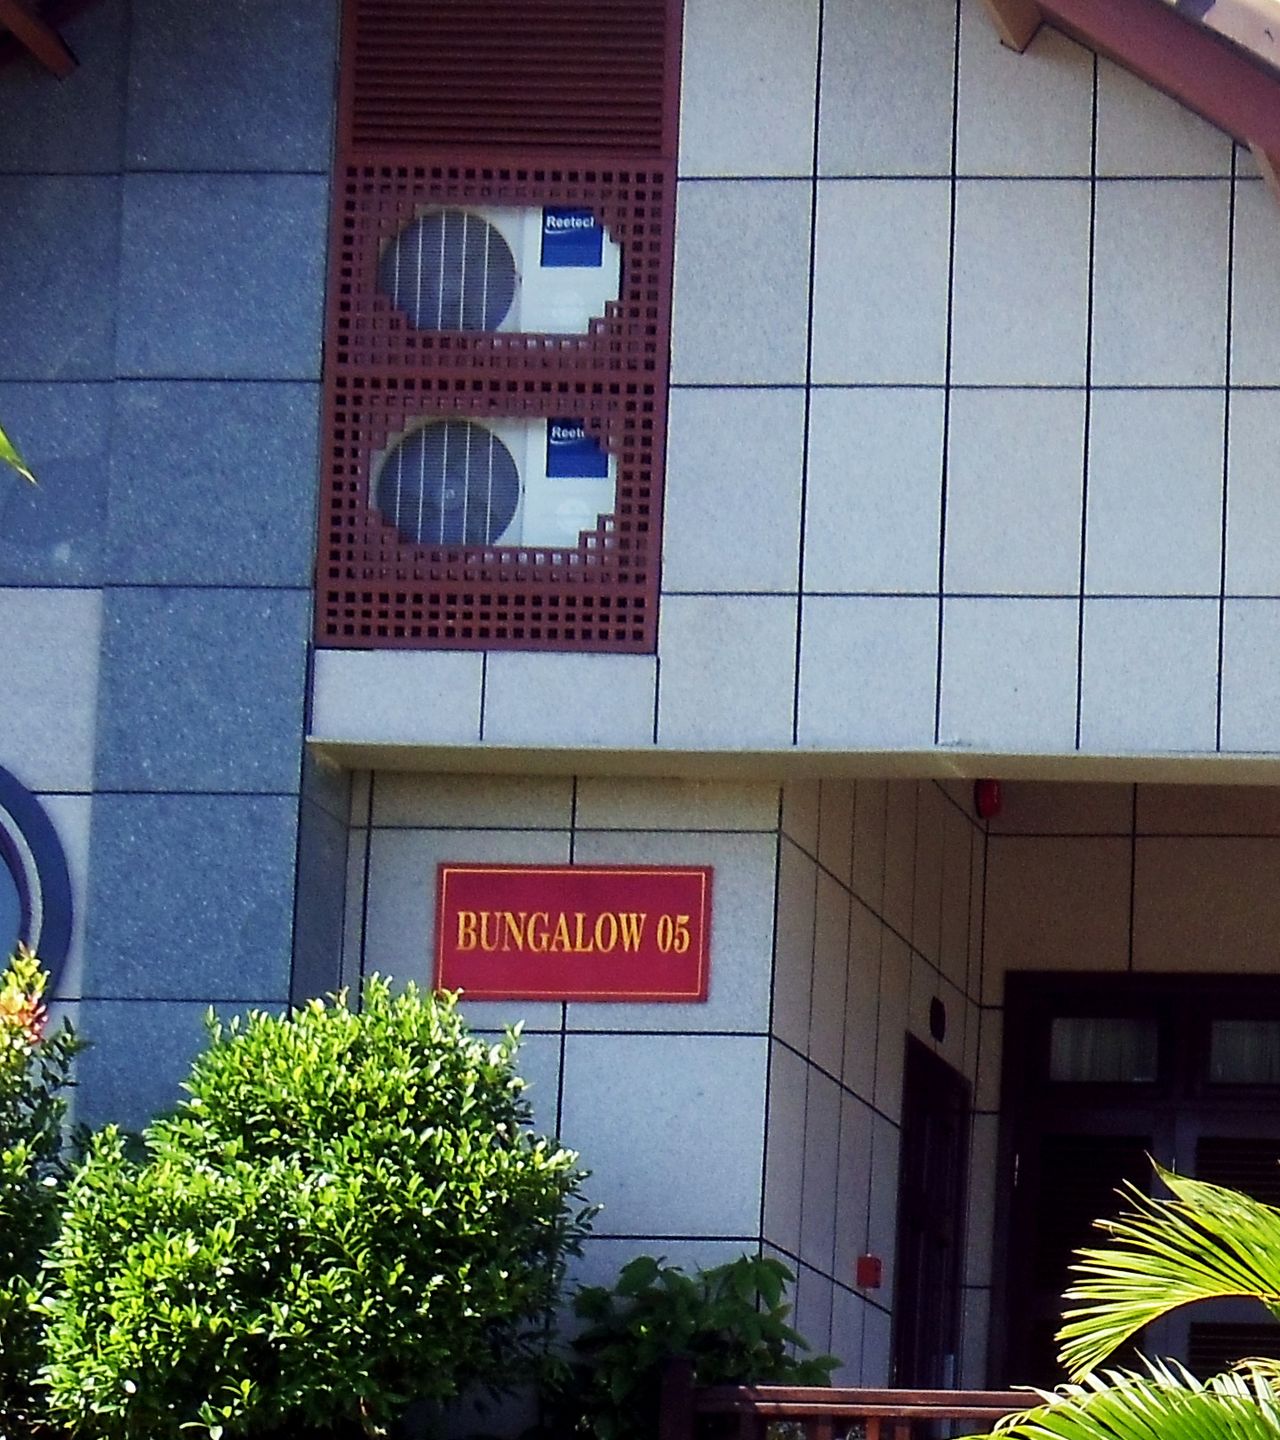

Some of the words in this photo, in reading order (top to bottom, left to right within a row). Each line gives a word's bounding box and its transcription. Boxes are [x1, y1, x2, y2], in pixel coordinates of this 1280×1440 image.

[551, 426, 585, 439] Reet
[456, 911, 647, 952] BUNGALOW
[656, 914, 690, 953] 05
